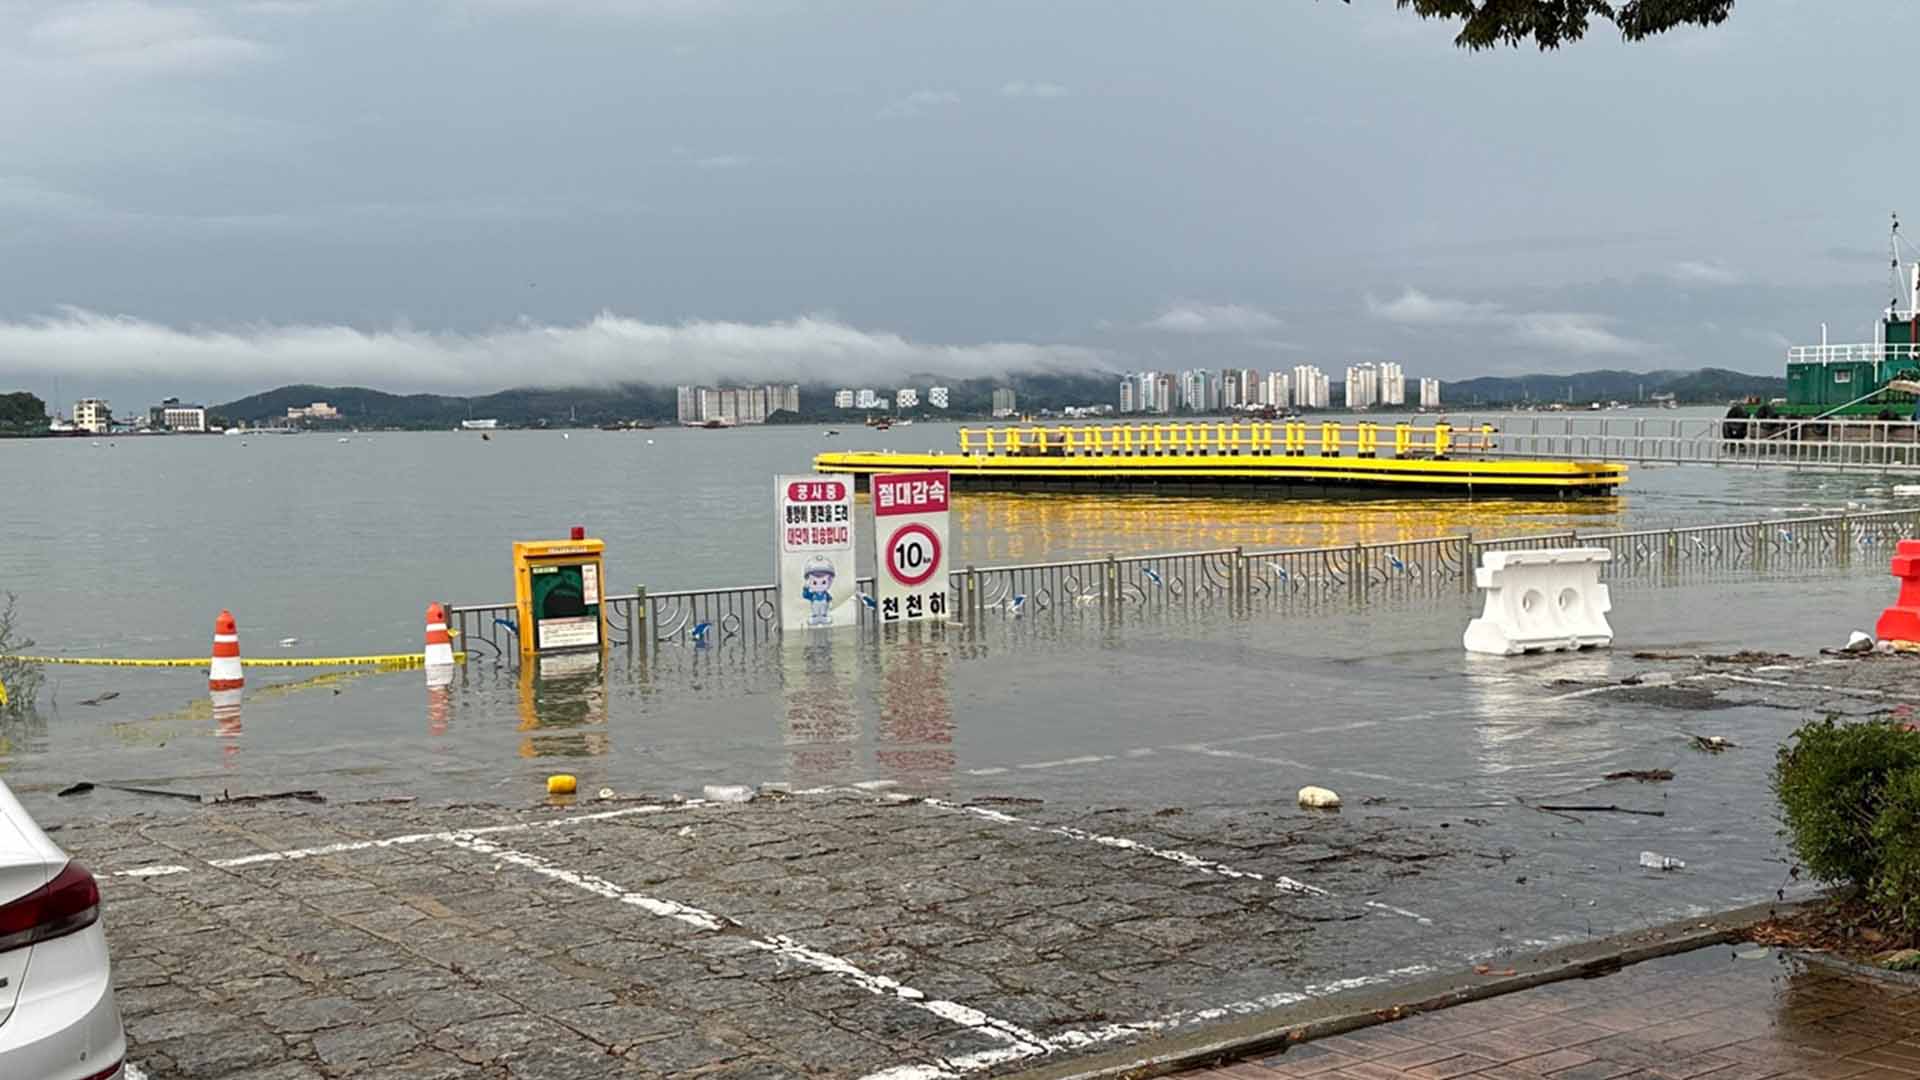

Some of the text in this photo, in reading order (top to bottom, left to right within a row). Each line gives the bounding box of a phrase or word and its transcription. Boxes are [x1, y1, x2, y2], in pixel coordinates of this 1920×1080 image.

[797, 484, 837, 500] 공사중
[878, 480, 945, 507] 절대감속
[896, 542, 922, 569] 10
[883, 592, 946, 620] 천천히
